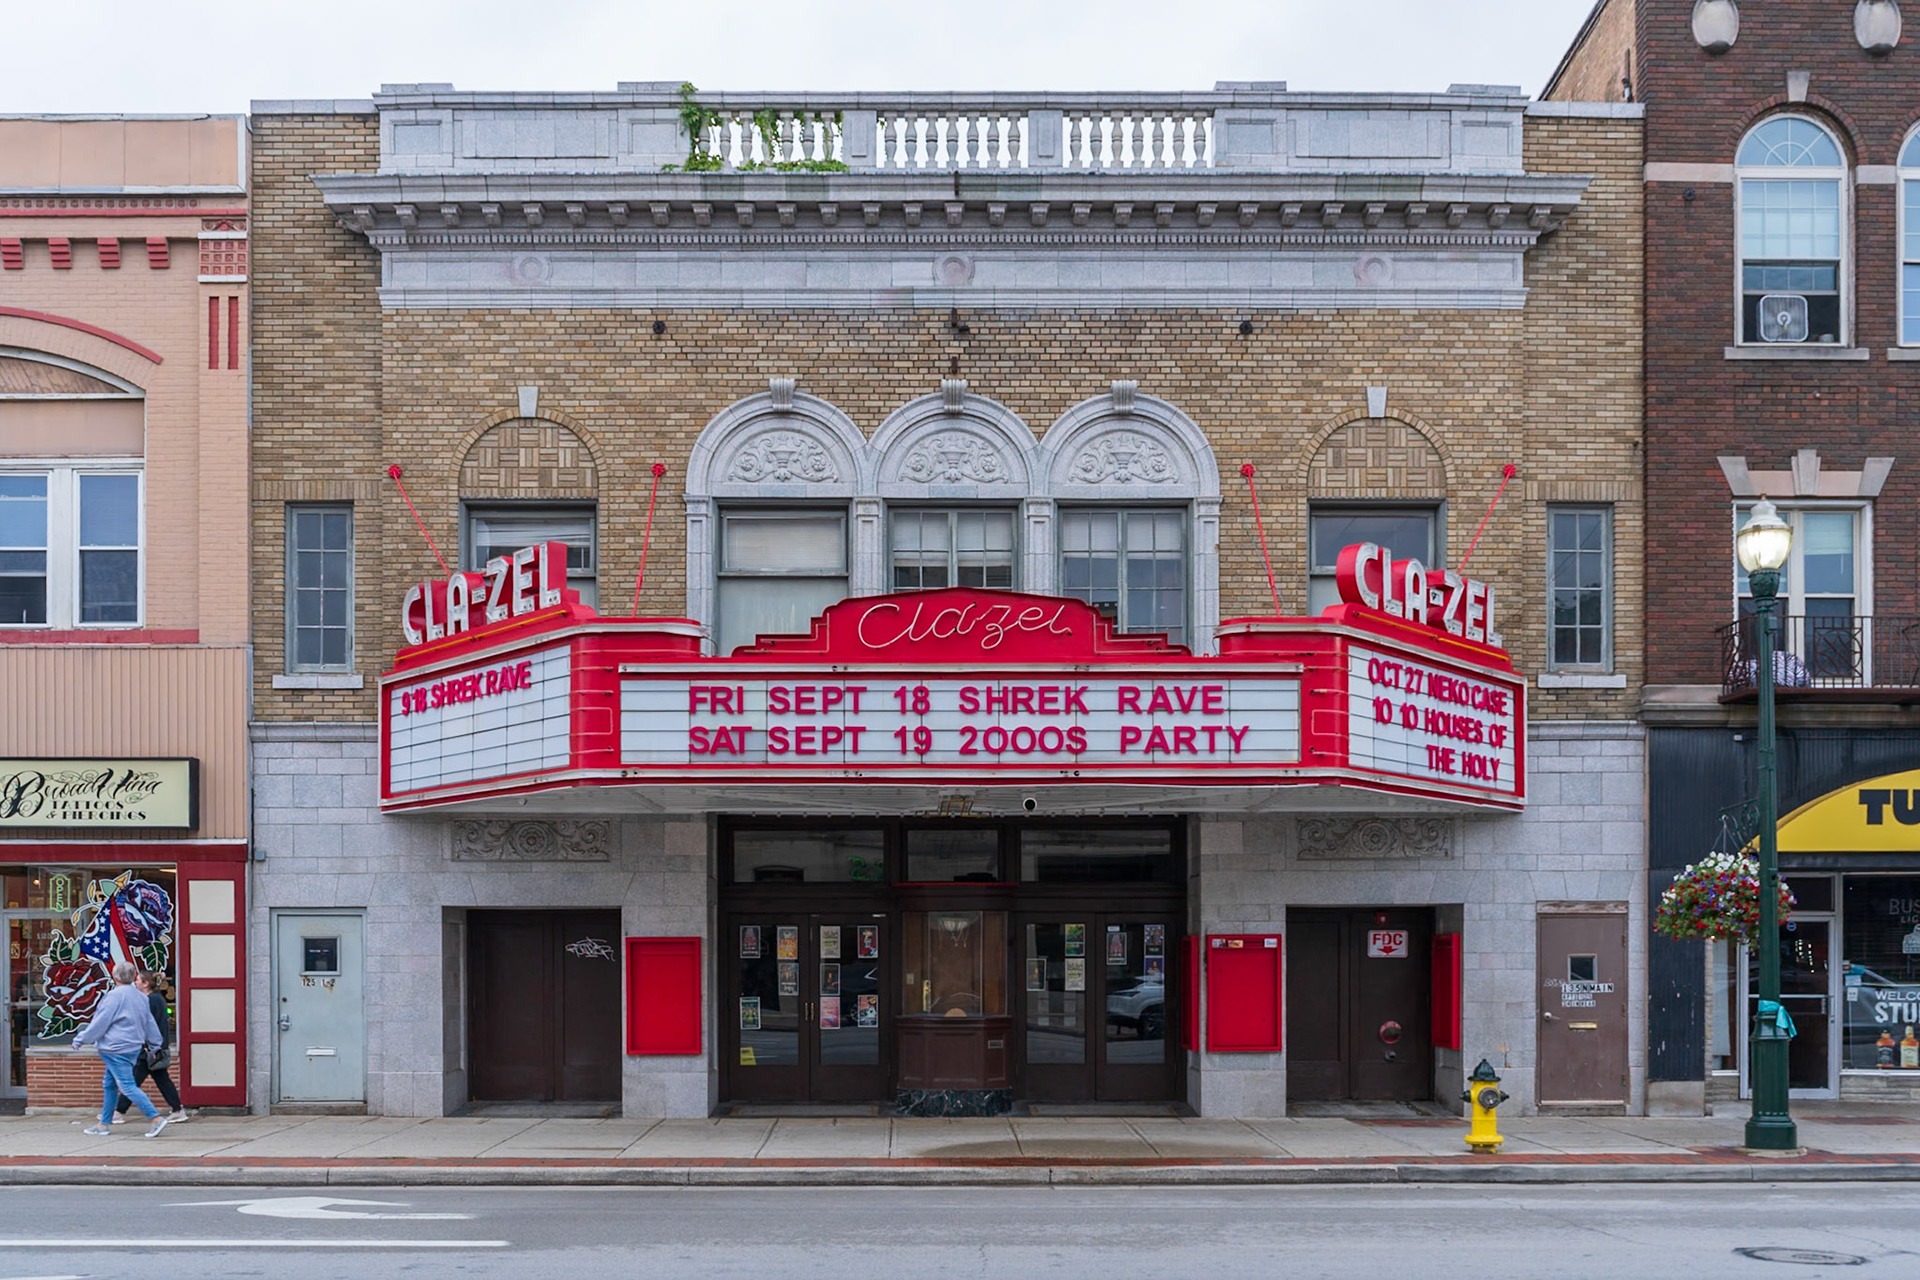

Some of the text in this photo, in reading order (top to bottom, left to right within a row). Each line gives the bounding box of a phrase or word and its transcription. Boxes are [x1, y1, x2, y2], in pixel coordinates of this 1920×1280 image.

[402, 541, 562, 646] CLA-ZEL
[1354, 541, 1503, 648] CLA-ZEL
[858, 602, 1073, 650] Clazel
[411, 687, 428, 713] 18
[430, 672, 484, 709] SHREK
[485, 660, 533, 697] RAVE
[689, 685, 1225, 715] FRI SEPT 18 SHREK RAVE
[1368, 657, 1508, 717] OCT 27 NEKO CASE
[688, 725, 753, 755] SAT
[767, 725, 867, 755] SEPT
[893, 725, 933, 755] 19
[1119, 724, 1250, 755] PARTY
[1373, 696, 1508, 750] 10 10 HOUSES OF
[1426, 744, 1501, 781] THE HOLY
[46, 810, 147, 820] & PIERCINGS
[52, 800, 124, 810] TATTOOS
[1858, 788, 1920, 826] TU
[1372, 933, 1404, 946] FDC
[302, 978, 316, 987] 125
[1874, 1001, 1920, 1024] STU
